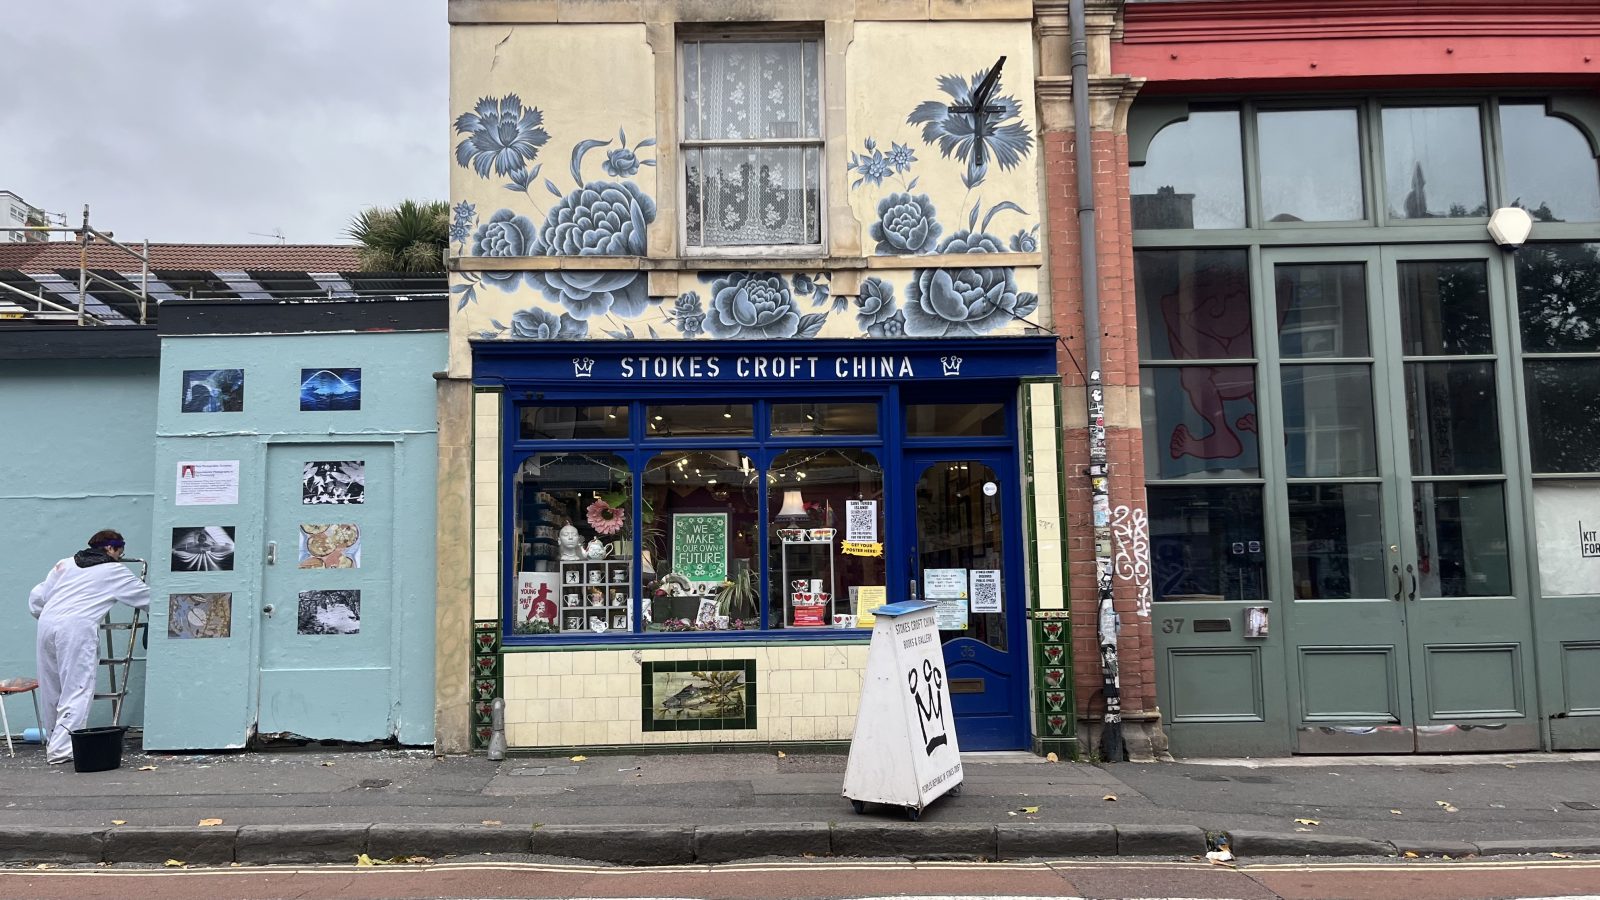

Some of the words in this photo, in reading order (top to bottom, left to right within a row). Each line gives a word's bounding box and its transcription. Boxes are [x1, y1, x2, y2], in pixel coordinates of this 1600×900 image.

[620, 356, 720, 378] STOKES
[736, 356, 819, 378] CROFT
[835, 356, 914, 378] CHINA
[693, 524, 708, 534] WE
[686, 534, 715, 544] MAKE
[1583, 531, 1597, 542] KIT
[682, 544, 699, 553] OUR
[699, 544, 719, 553] OWN
[679, 552, 721, 564] FUTURE
[519, 597, 532, 605] SHUT
[895, 621, 911, 635] STOKES
[910, 618, 923, 631] CROFT
[923, 615, 936, 628] CHINA
[1161, 618, 1185, 634] 37
[903, 638, 914, 650] BOOKS
[918, 633, 932, 645] GALLERY
[960, 645, 976, 657] 35
